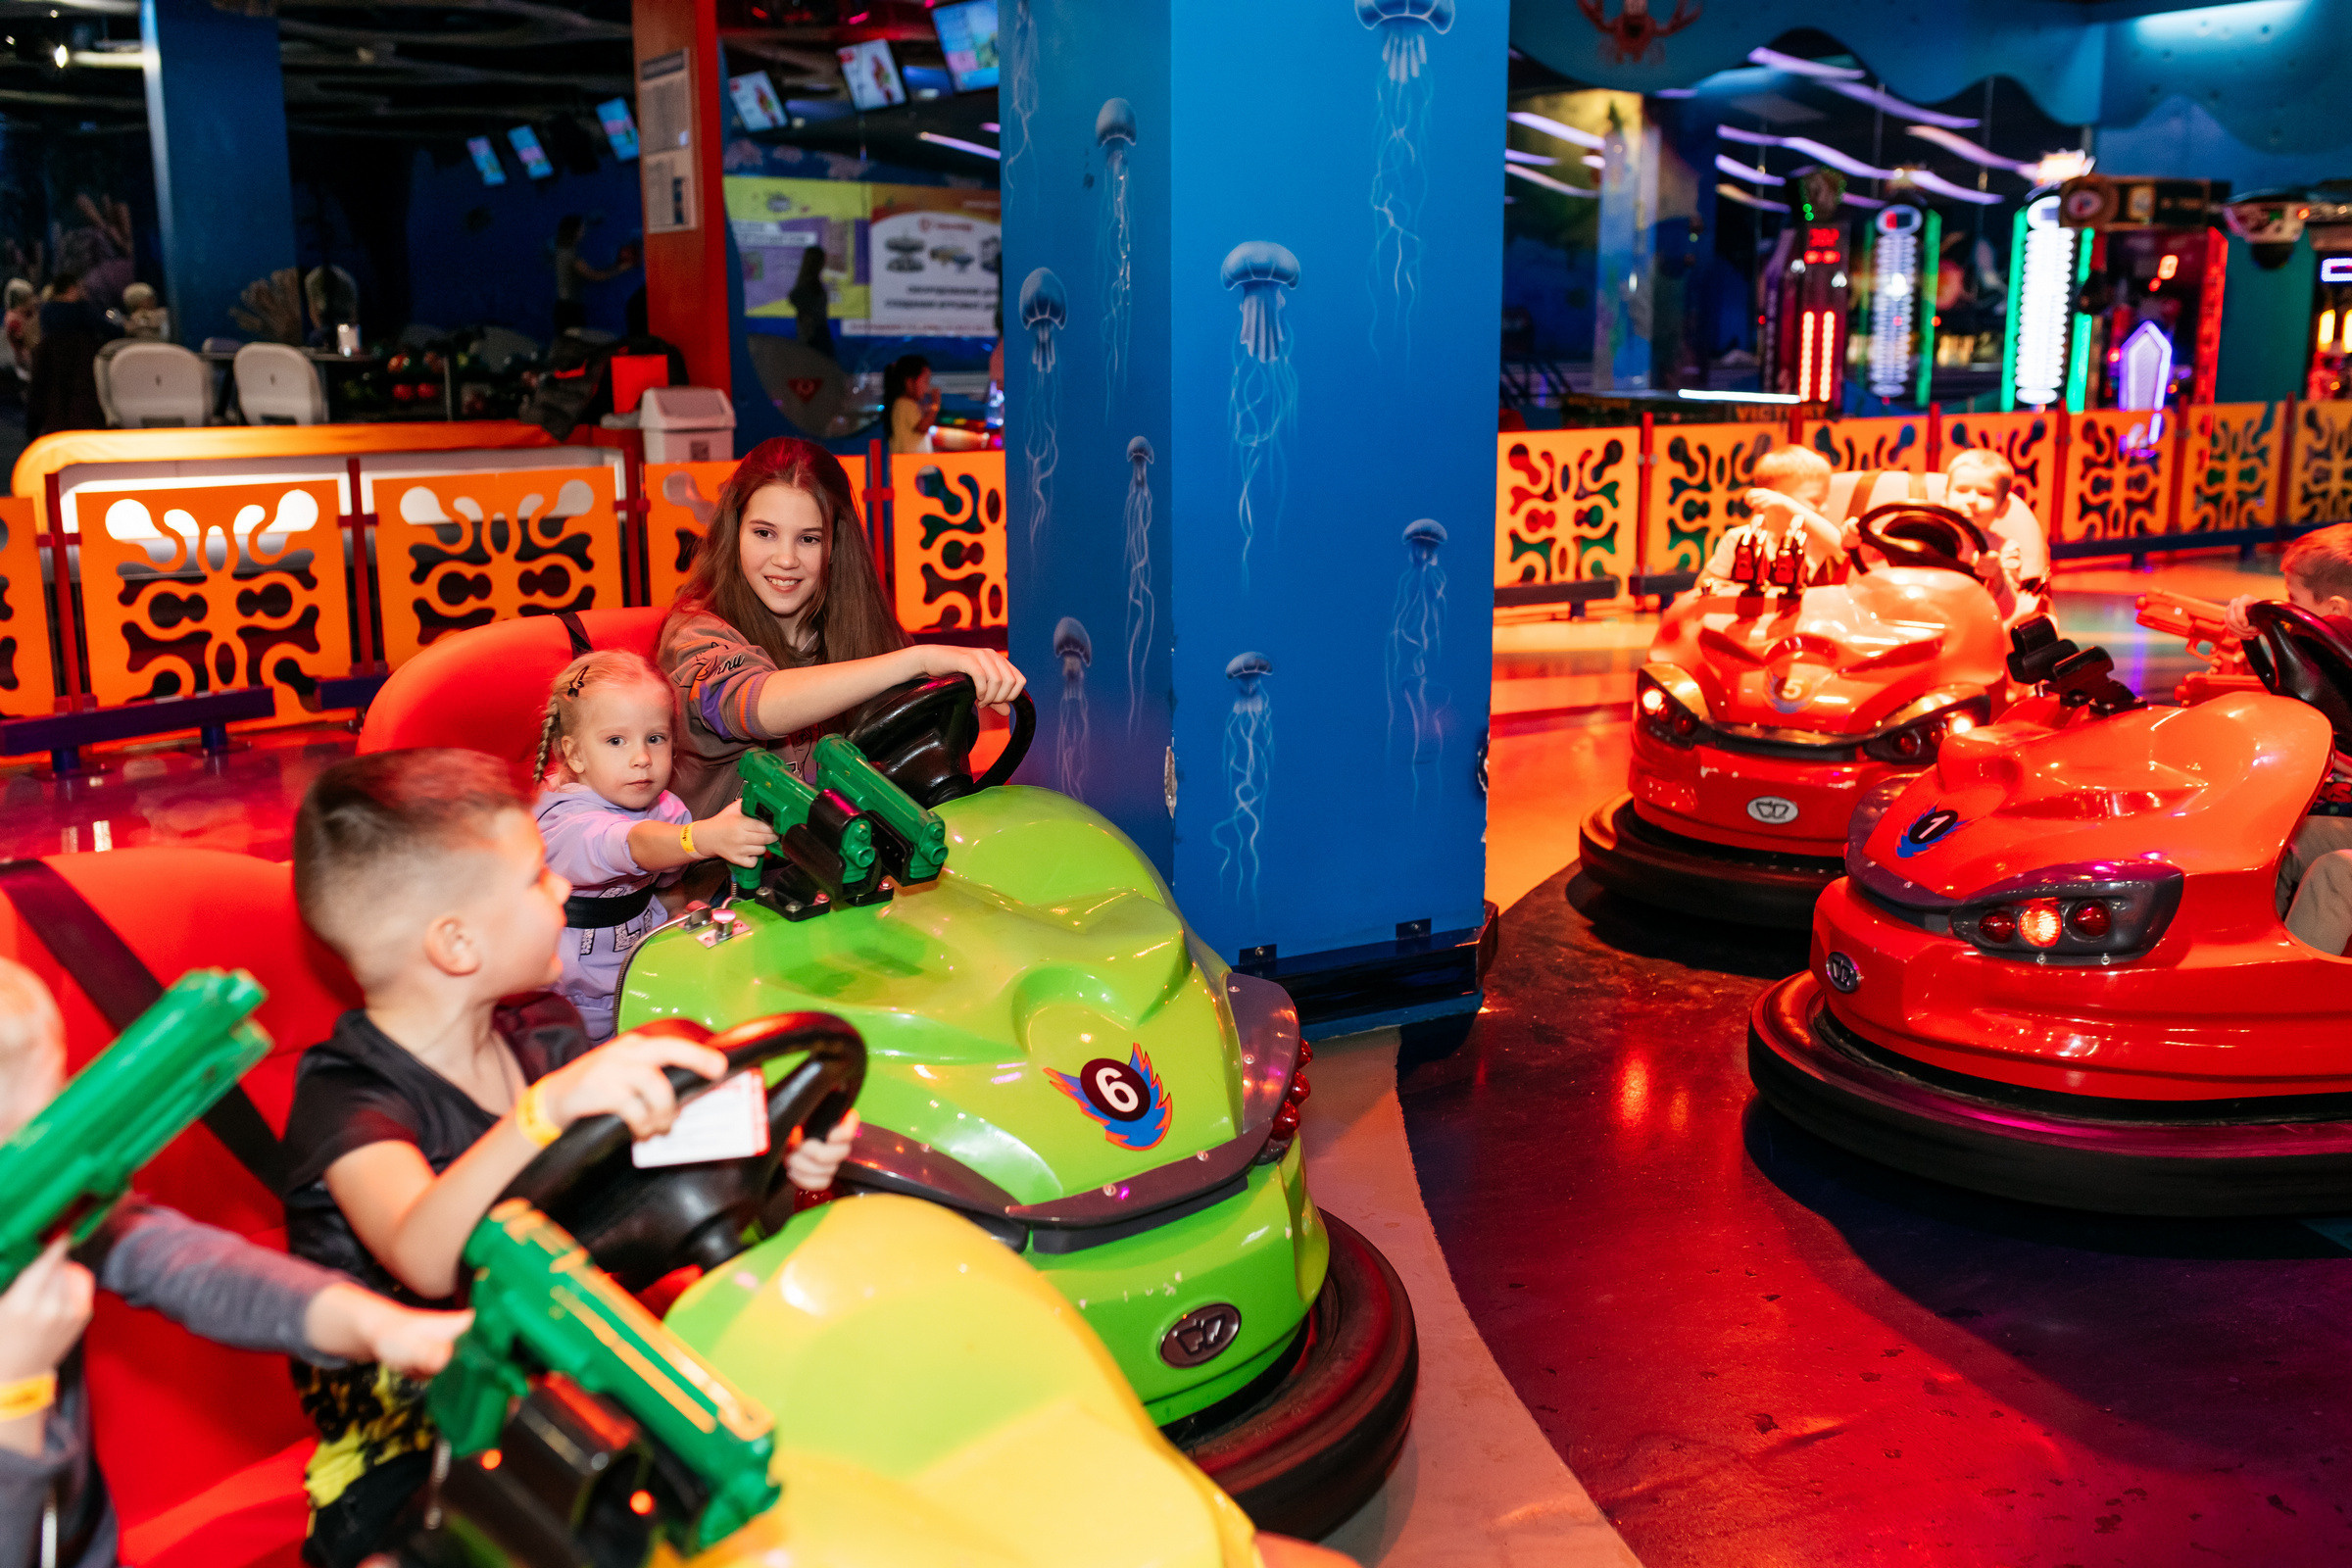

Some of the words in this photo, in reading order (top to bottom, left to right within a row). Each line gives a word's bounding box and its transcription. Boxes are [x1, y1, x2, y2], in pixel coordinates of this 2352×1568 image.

[1736, 404, 1829, 422] VICTRY
[1781, 678, 1803, 700] 5
[1918, 814, 1950, 840] 1
[1096, 1067, 1138, 1112] 6
